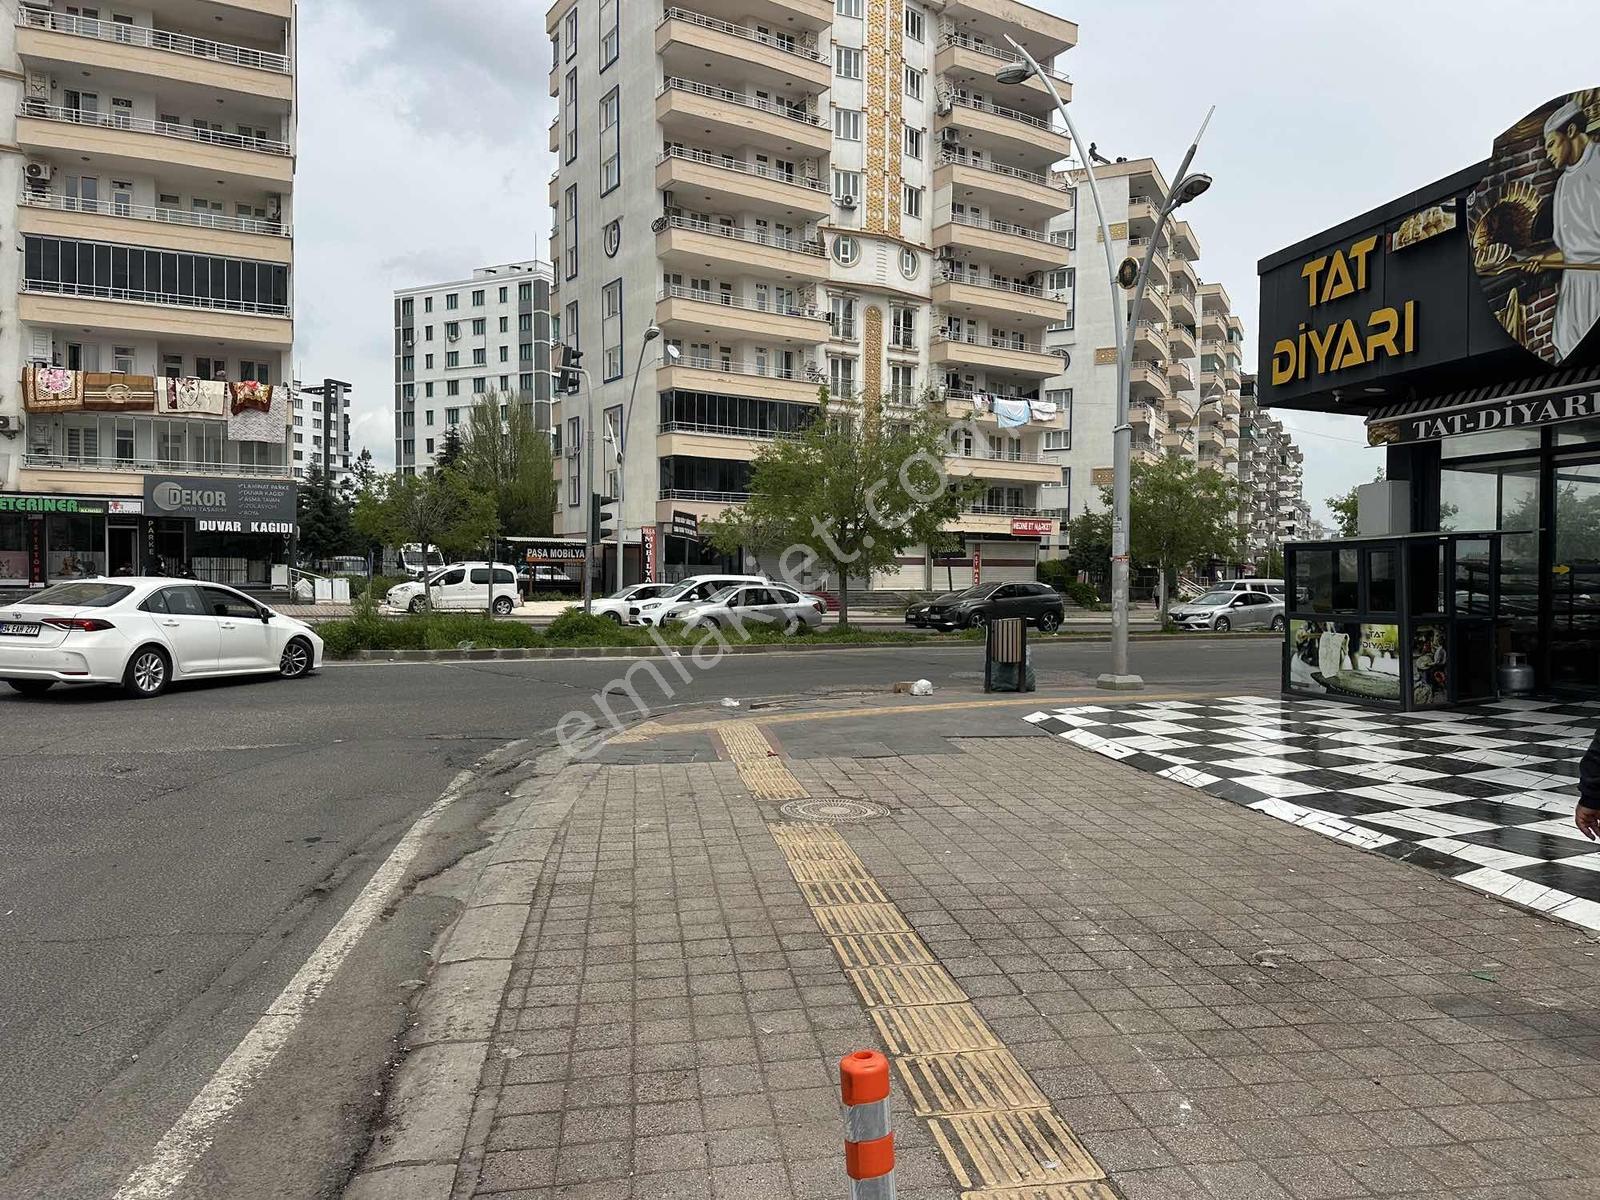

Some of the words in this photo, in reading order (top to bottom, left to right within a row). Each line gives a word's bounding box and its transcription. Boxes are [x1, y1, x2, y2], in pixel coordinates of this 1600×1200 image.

[1301, 234, 1378, 307] TAT
[1272, 300, 1414, 386] DİYARI
[169, 488, 227, 507] DEKOR
[147, 520, 155, 556] PARKE
[200, 520, 242, 532] DUVAR
[527, 548, 548, 559] PAŞA
